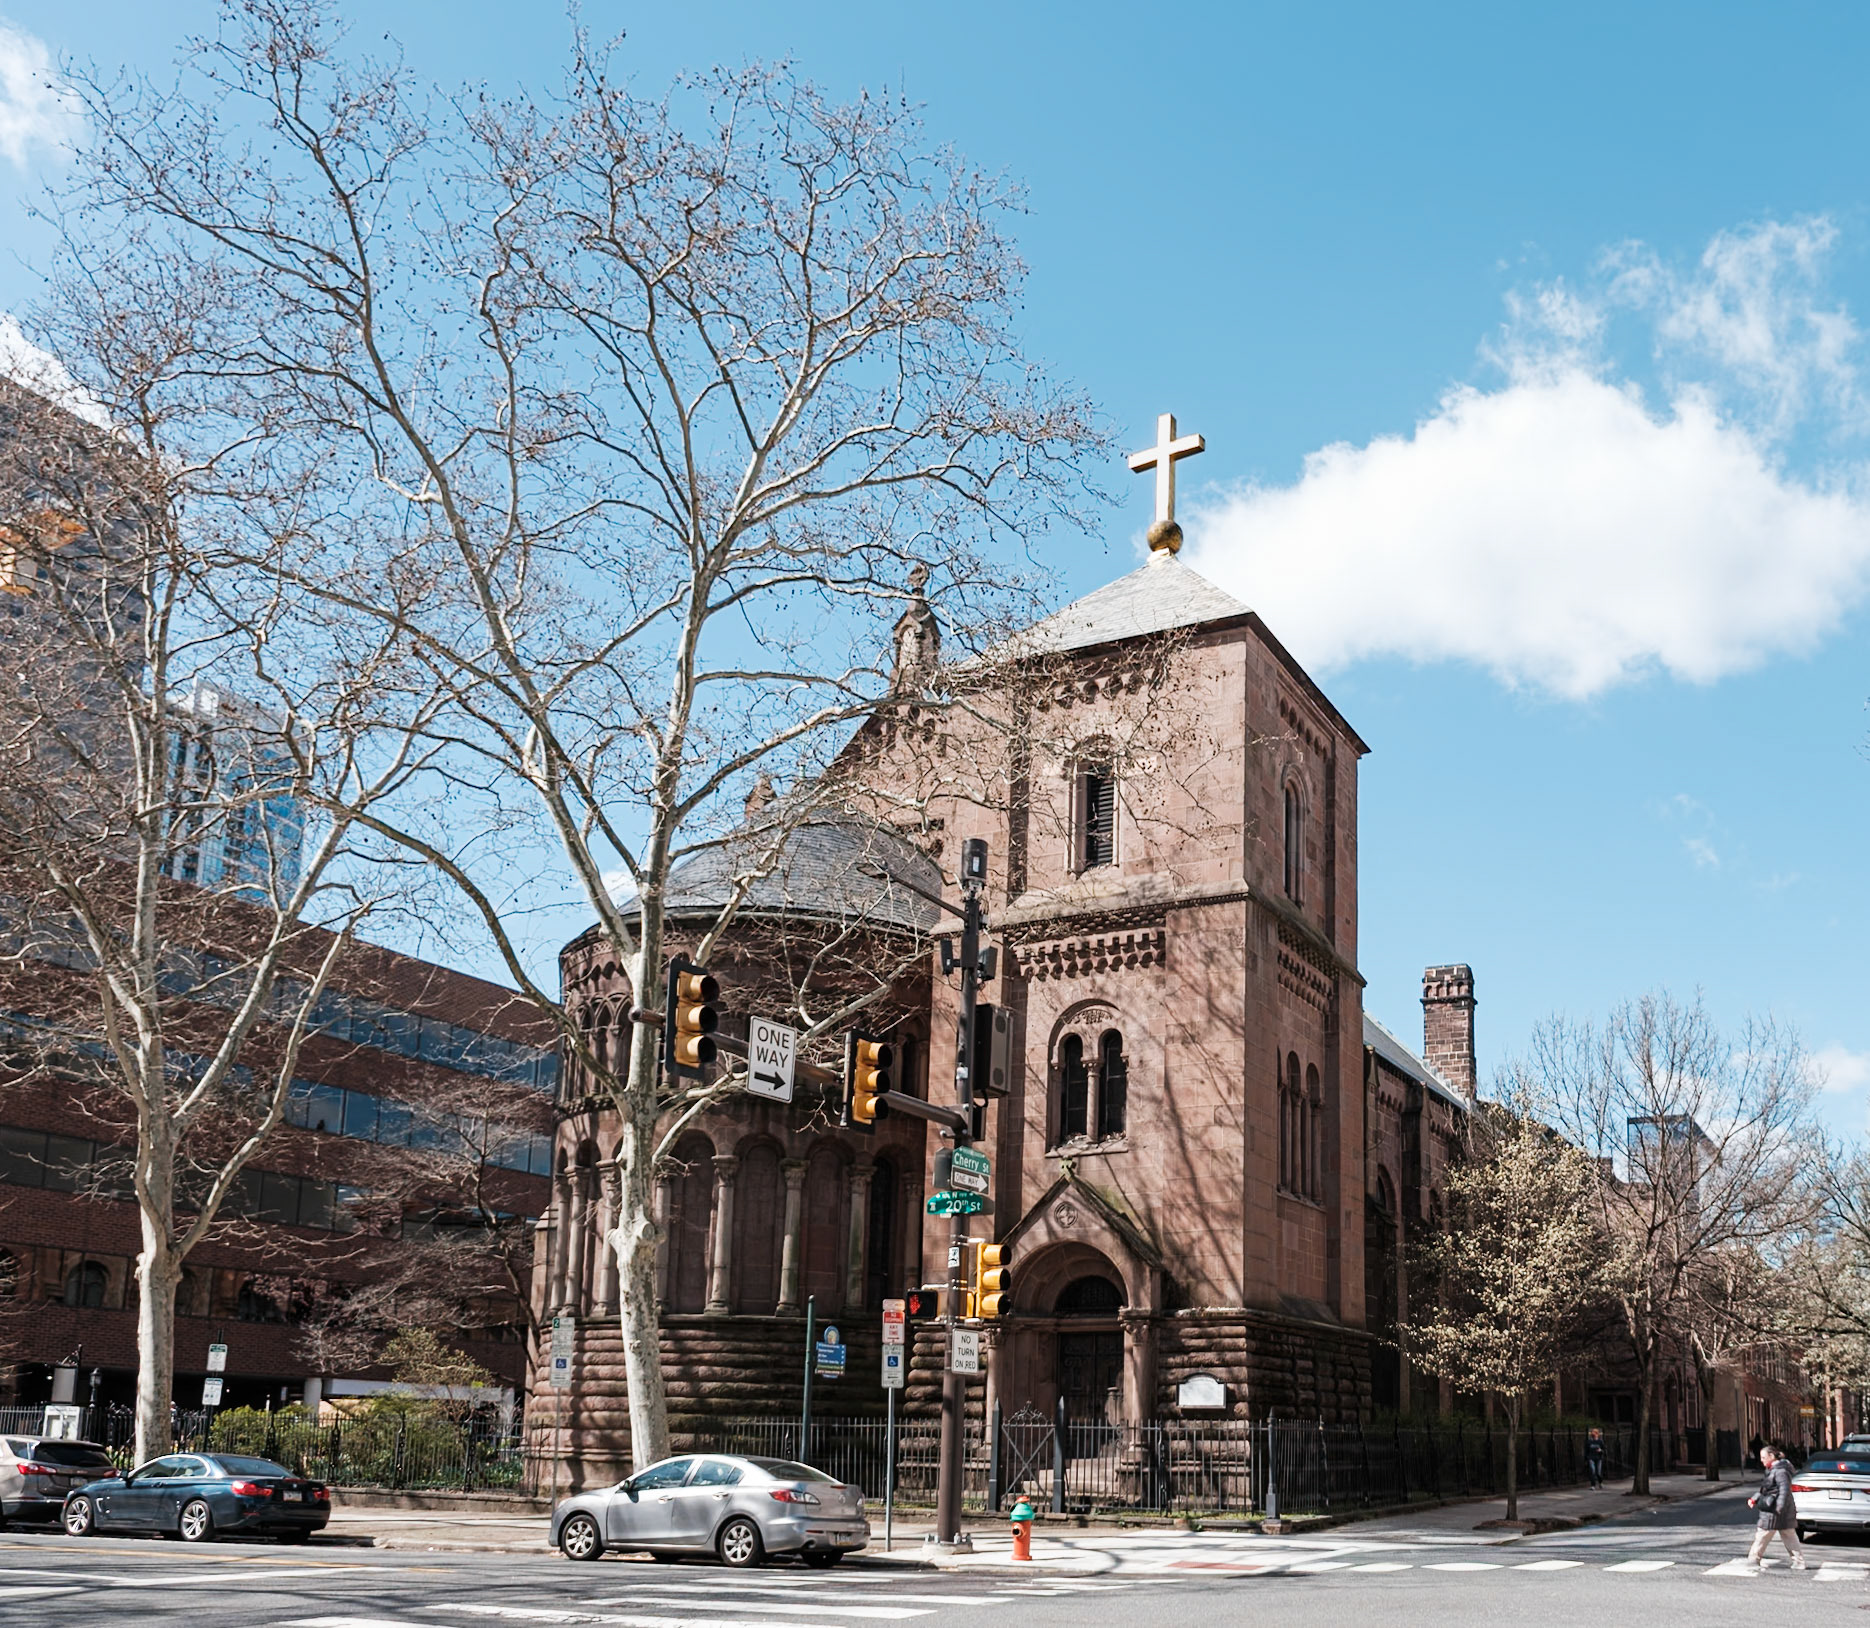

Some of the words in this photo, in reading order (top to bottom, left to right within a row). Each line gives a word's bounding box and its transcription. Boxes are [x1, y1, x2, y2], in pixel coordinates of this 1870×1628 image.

[757, 1026, 790, 1049] ONE
[756, 1045, 789, 1068] WAY
[954, 1152, 979, 1172] Cherry
[982, 1162, 989, 1174] St
[955, 1173, 966, 1183] ONE
[968, 1177, 978, 1186] WAY
[970, 1202, 981, 1211] St
[961, 1335, 971, 1344] NO
[958, 1347, 975, 1356] TURN
[955, 1360, 964, 1368] ON
[965, 1361, 976, 1369] RED
